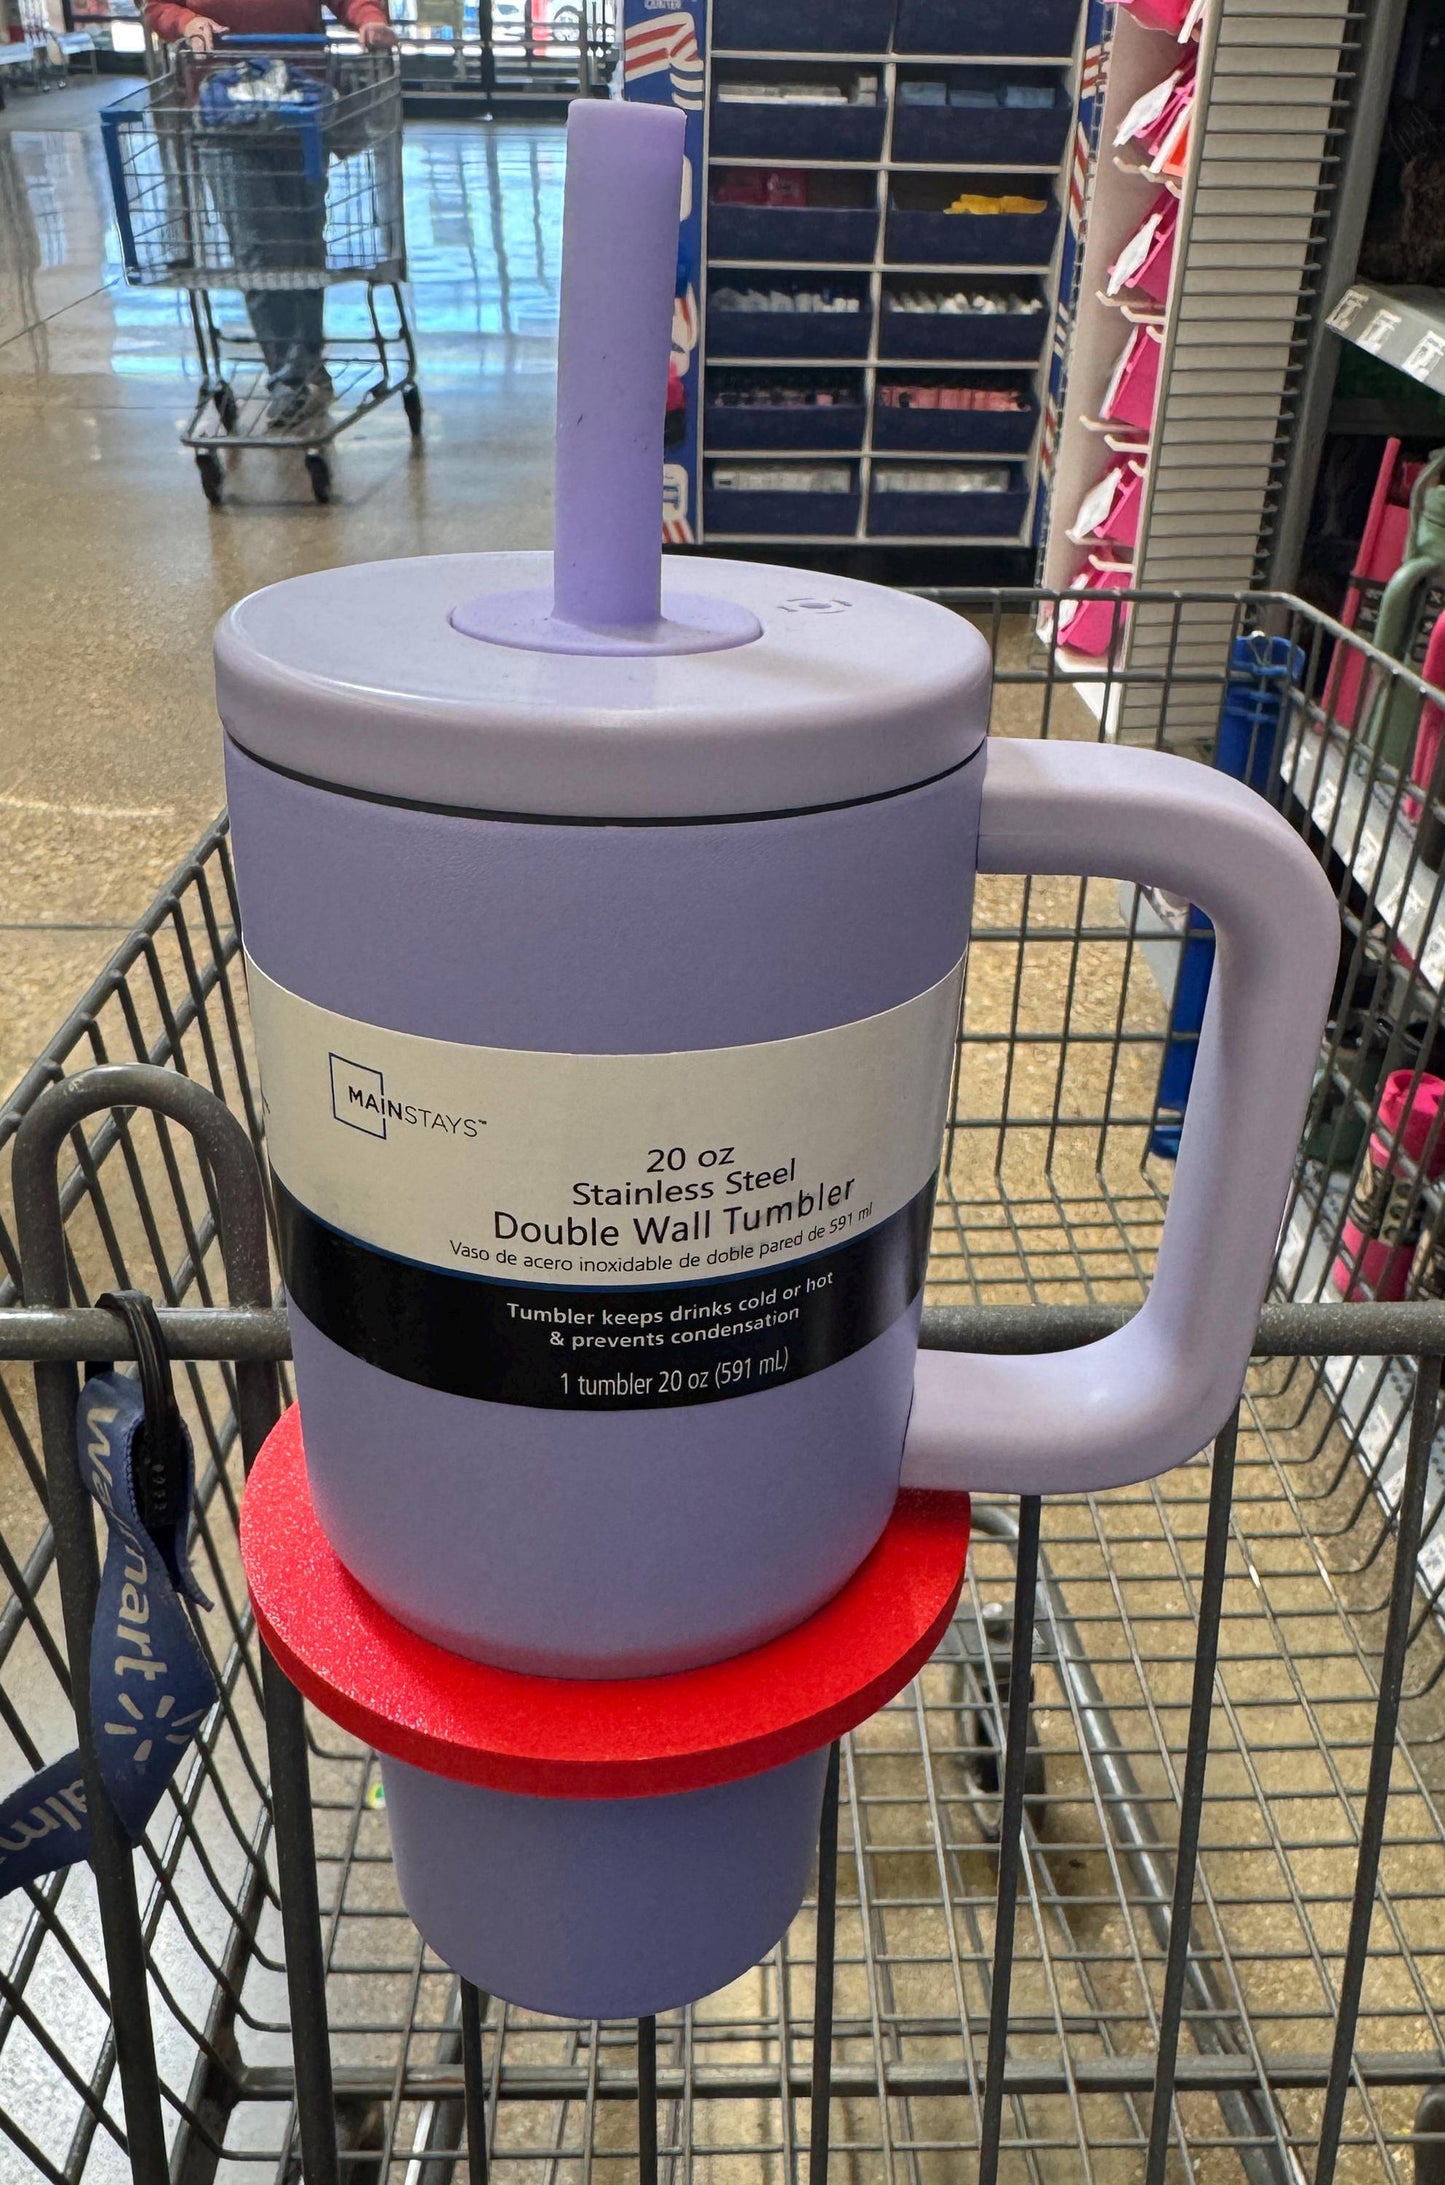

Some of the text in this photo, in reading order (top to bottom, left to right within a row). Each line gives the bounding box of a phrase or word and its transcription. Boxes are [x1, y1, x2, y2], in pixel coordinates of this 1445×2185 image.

[572, 1157, 796, 1206] Stainless Steel
[646, 1146, 735, 1173] 20 oz
[449, 1201, 873, 1272] Vaso de acero inoxidable de doble pared de 591 ml
[494, 1178, 856, 1247] Double Wall Tumbler
[506, 1272, 833, 1328] Tumbler keeps drinks cold or hot
[550, 1307, 799, 1351] & prevents condensation
[560, 1346, 789, 1396] 1 tumbler 20 oz (591 mL)
